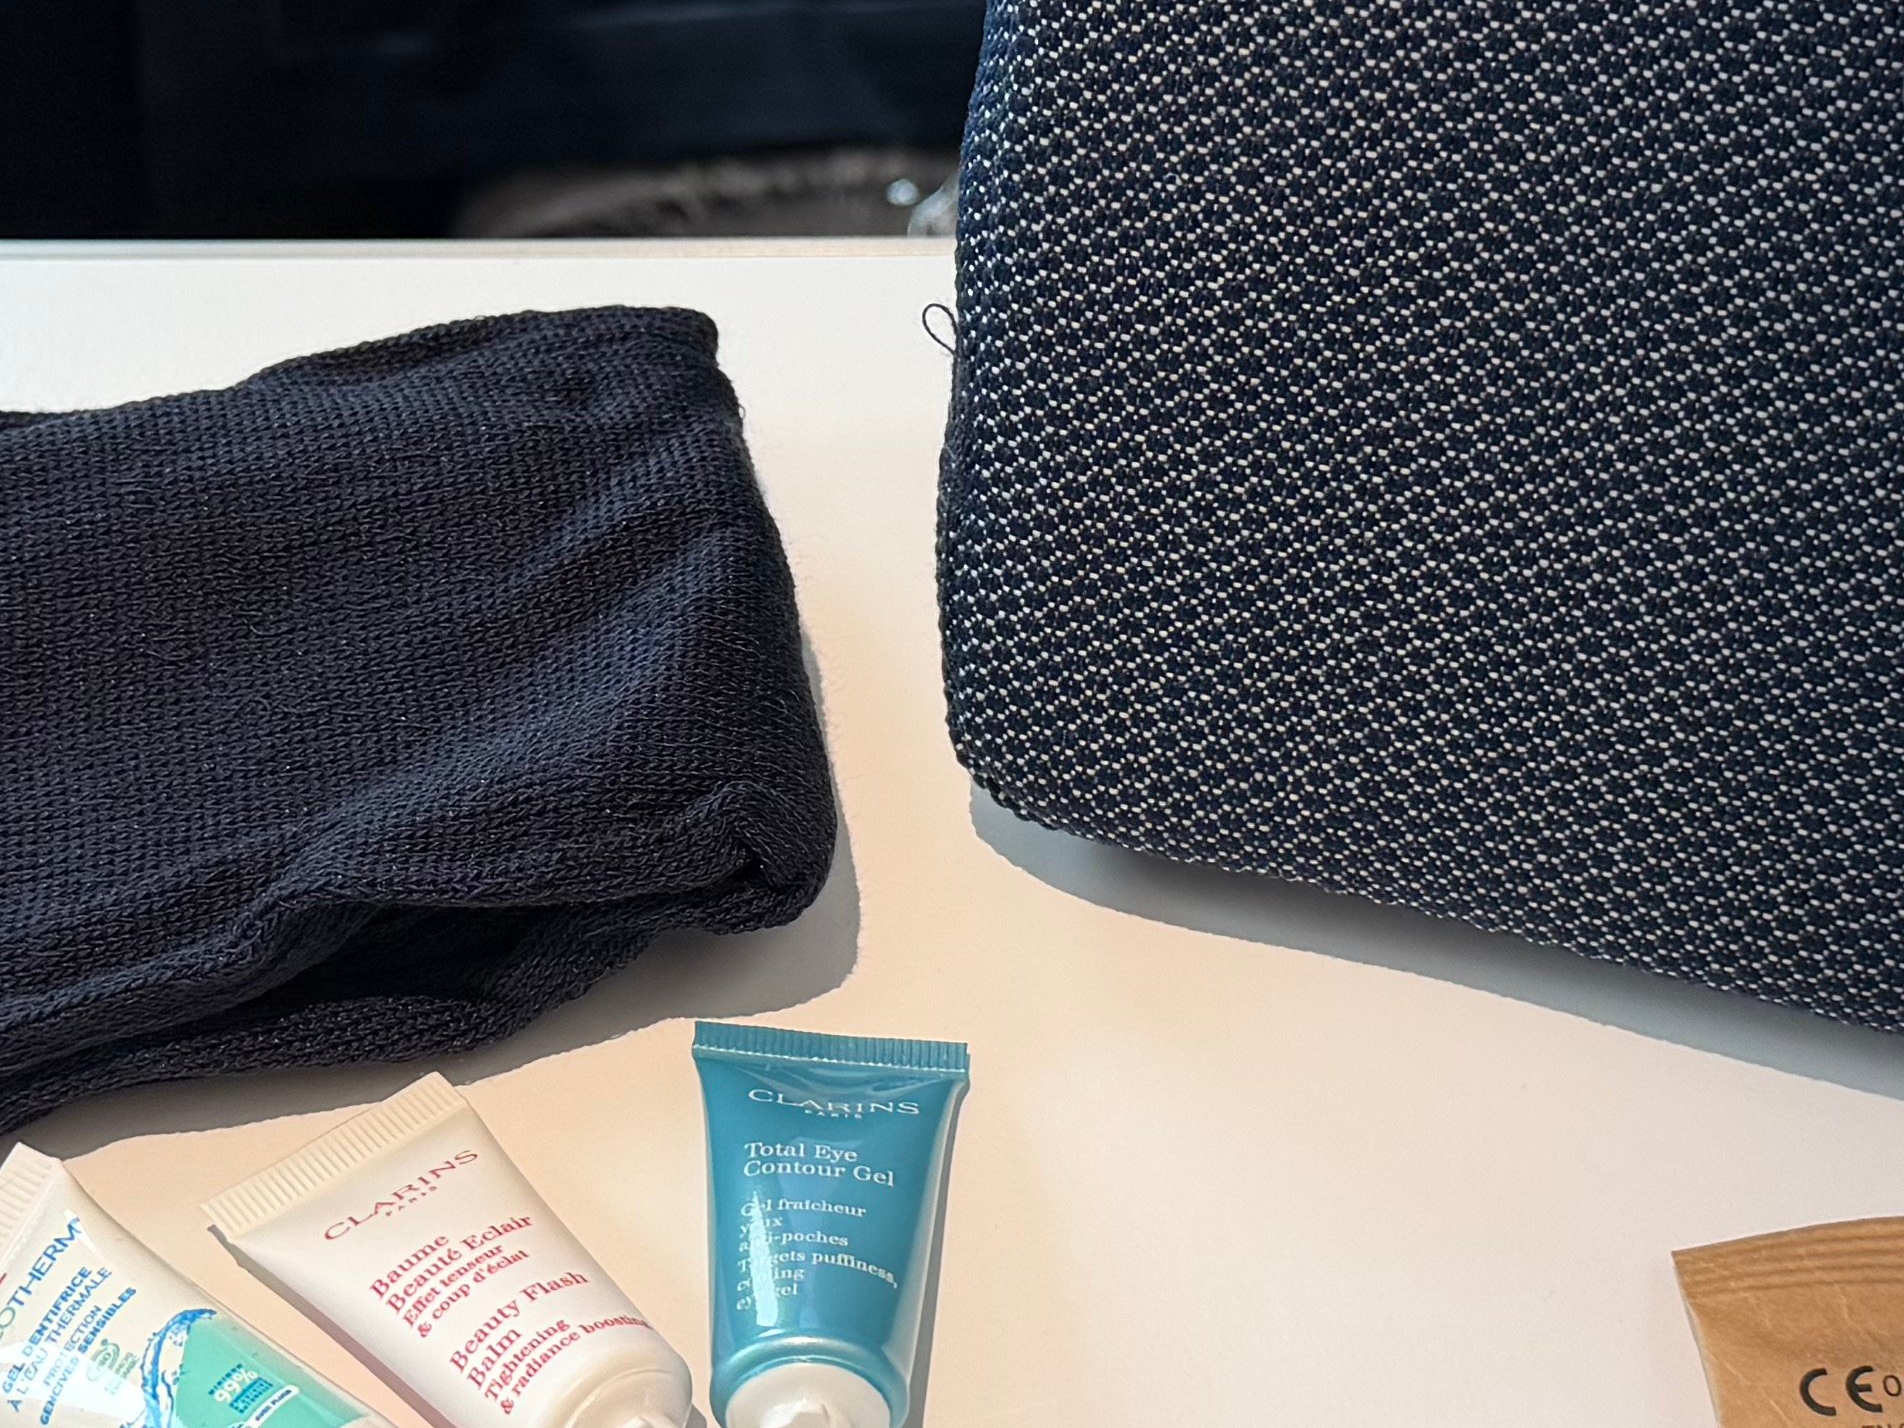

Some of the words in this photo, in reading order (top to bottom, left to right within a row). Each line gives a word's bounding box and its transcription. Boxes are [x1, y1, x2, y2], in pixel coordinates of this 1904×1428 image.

[748, 1089, 920, 1115] CLARINS
[743, 1160, 846, 1178] Contour
[853, 1165, 895, 1187] Gel
[744, 1142, 805, 1159] Total
[815, 1145, 858, 1164] Eye
[324, 1149, 479, 1241] CLARINS
[740, 1198, 772, 1218] Gl
[369, 1234, 450, 1300] Baume
[385, 1248, 463, 1315] Beauté
[460, 1214, 533, 1251] Eclair
[739, 1230, 849, 1253] ai-poches
[46, 1266, 113, 1345] THERMALE
[402, 1285, 441, 1329] Effet
[439, 1243, 504, 1288] tenseur
[417, 1320, 433, 1339] &
[431, 1281, 472, 1321] coup
[1, 1361, 27, 1394] GEL
[22, 1266, 93, 1359] DENTIFRICE
[42, 1303, 103, 1389] PROTECTION
[76, 1286, 138, 1356] SENSIBLES
[449, 1298, 521, 1374] Beauty
[519, 1270, 590, 1304] Flash
[213, 1369, 259, 1403] 99%
[466, 1326, 523, 1391] Balm
[483, 1317, 572, 1404] Tightening
[499, 1395, 515, 1415] &
[511, 1329, 582, 1398] radiance
[1798, 1365, 1884, 1416] CE
